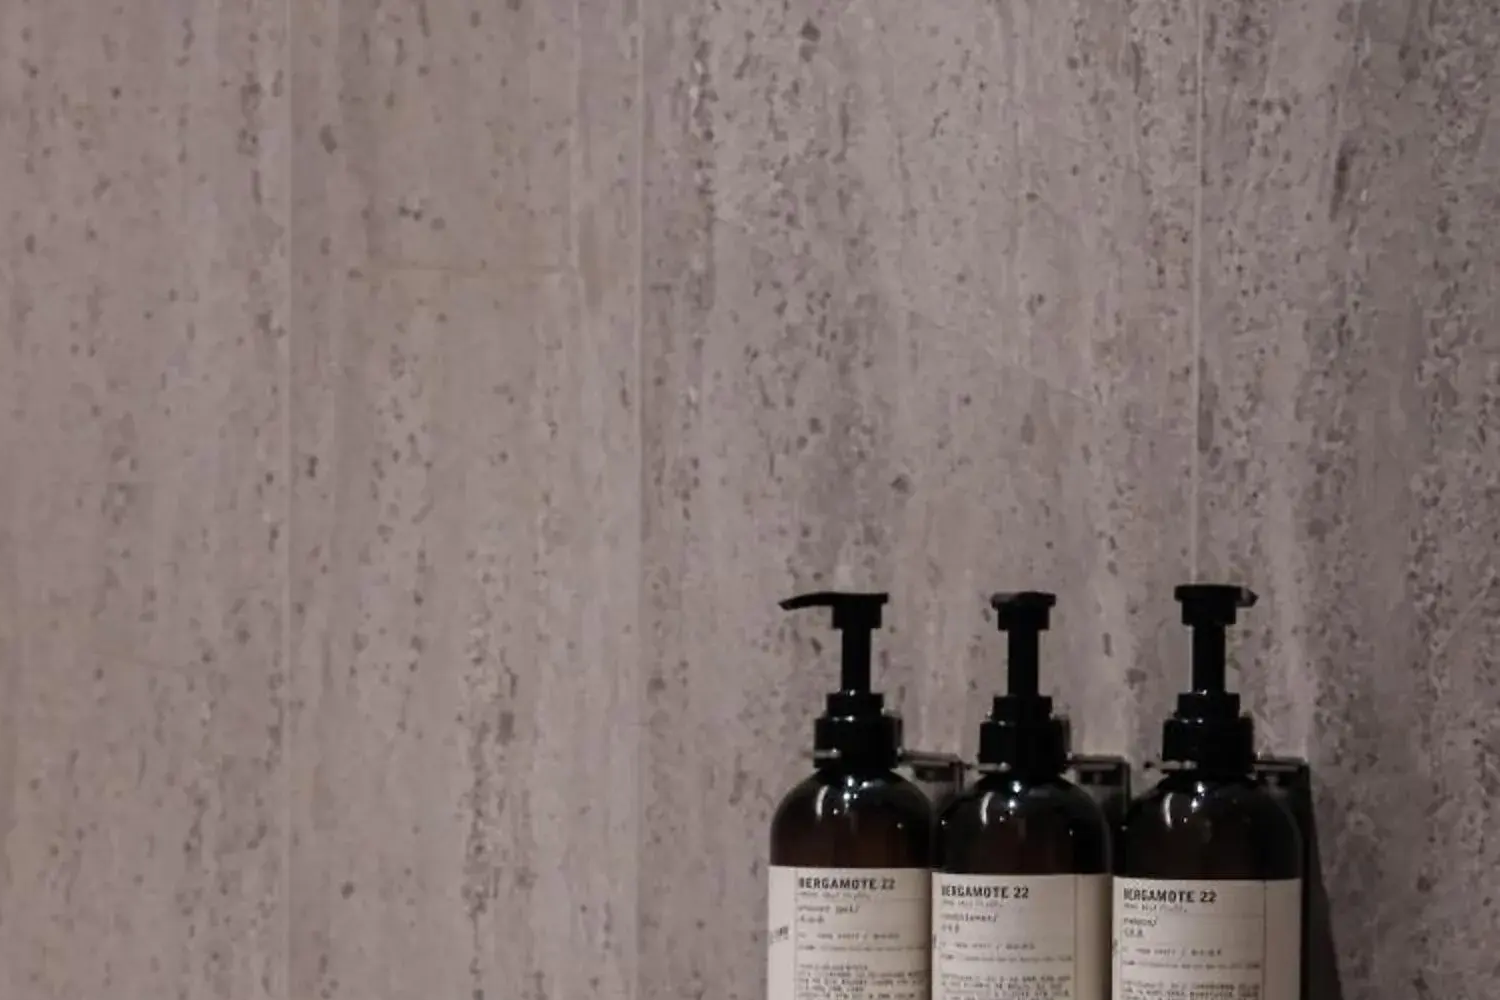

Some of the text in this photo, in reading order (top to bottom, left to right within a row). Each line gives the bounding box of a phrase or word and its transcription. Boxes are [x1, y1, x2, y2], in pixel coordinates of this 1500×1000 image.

[799, 877, 896, 891] BERGAMOTE 22
[941, 885, 1029, 899] BERGAMOTE 22
[1123, 888, 1217, 904] BERGAMOTE 22
